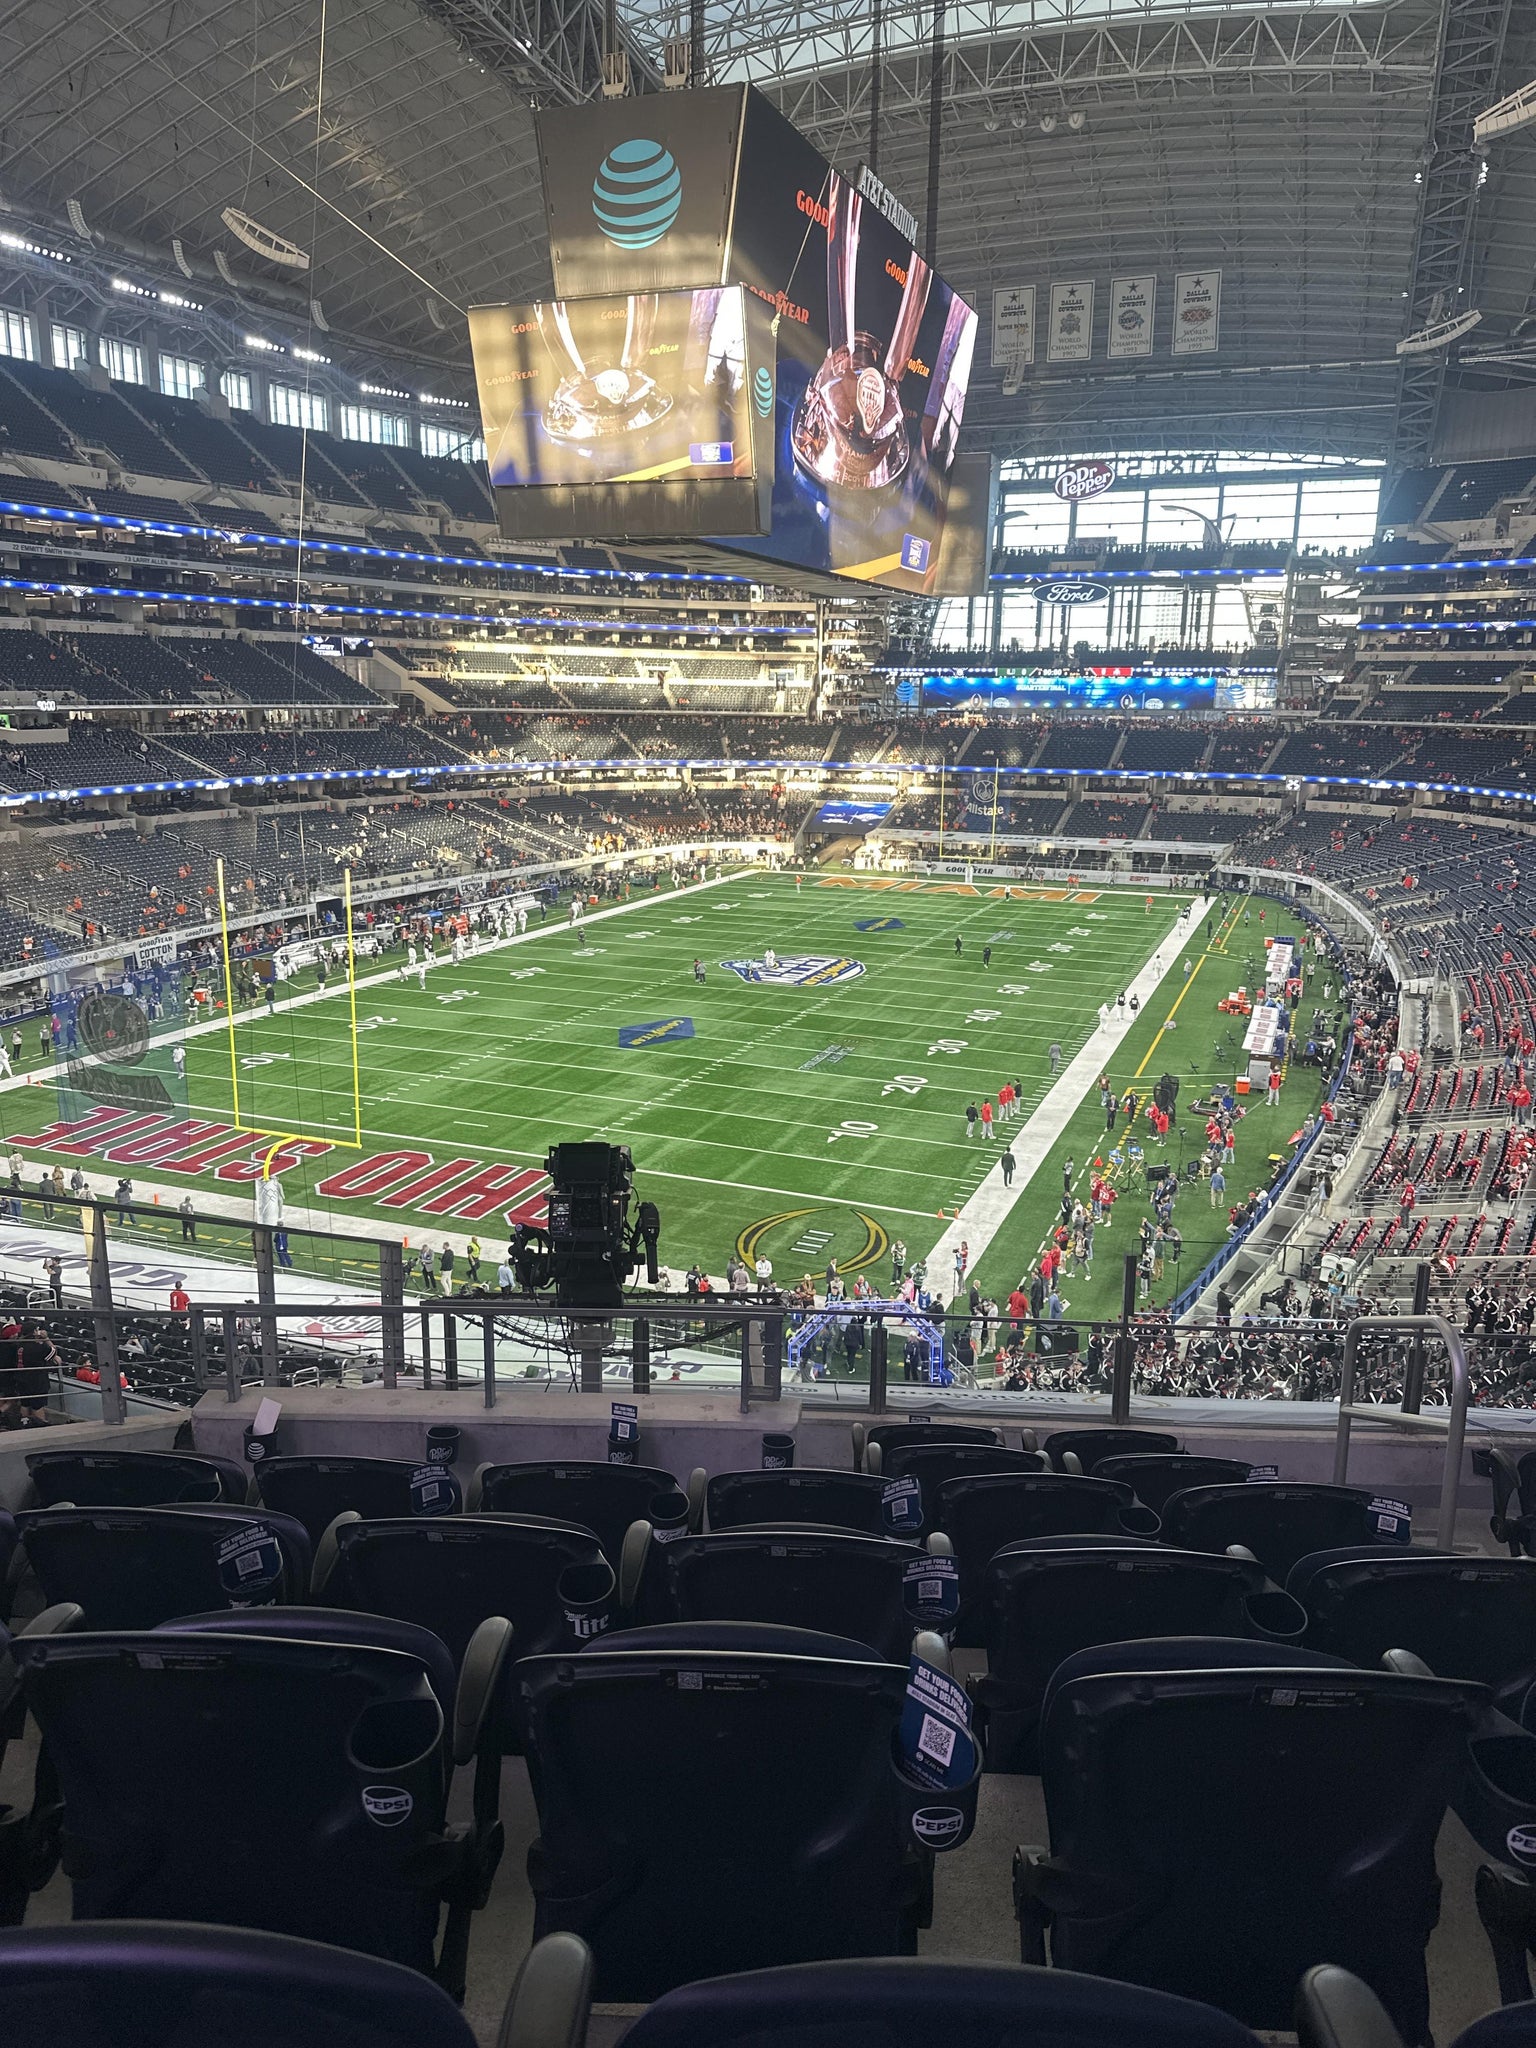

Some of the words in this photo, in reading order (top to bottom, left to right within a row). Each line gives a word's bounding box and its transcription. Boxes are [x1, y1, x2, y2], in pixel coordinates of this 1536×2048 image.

[857, 165, 885, 209] AT&T
[879, 188, 919, 246] STADIUM
[1187, 289, 1209, 297] DALLAS
[1187, 311, 1207, 320] XXX
[1176, 336, 1214, 344] CHAMPIONS
[1051, 344, 1087, 352] CHAMPIONS
[485, 370, 539, 386] GOODYEAR
[1077, 466, 1098, 482] Dr
[1061, 471, 1112, 497] Pepper
[20, 545, 44, 553] EMMITT
[1047, 585, 1094, 601] Ford
[965, 802, 1004, 816] Allstate
[945, 865, 994, 875] GOODYEAR
[812, 877, 1104, 904] MIAMI
[281, 907, 307, 917] GOODYEAR
[185, 927, 214, 938] GOODYEAR
[139, 936, 173, 949] GOODYEAR
[139, 943, 173, 959] COTTON
[997, 984, 1031, 995] 50
[967, 1009, 1002, 1022] 40
[628, 1020, 685, 1046] GOODYEAR
[928, 1039, 969, 1054] 30
[883, 1075, 928, 1095] 20
[829, 1121, 879, 1138] 10
[1, 1105, 336, 1183] STATE
[573, 1614, 609, 1639] Lite
[914, 1674, 939, 1697] DRINKS
[918, 1665, 931, 1680] GET
[931, 1673, 950, 1692] YOUR
[950, 1684, 964, 1706] FOOD
[365, 1797, 410, 1810] PEPSI
[915, 1817, 962, 1832] PEPSI
